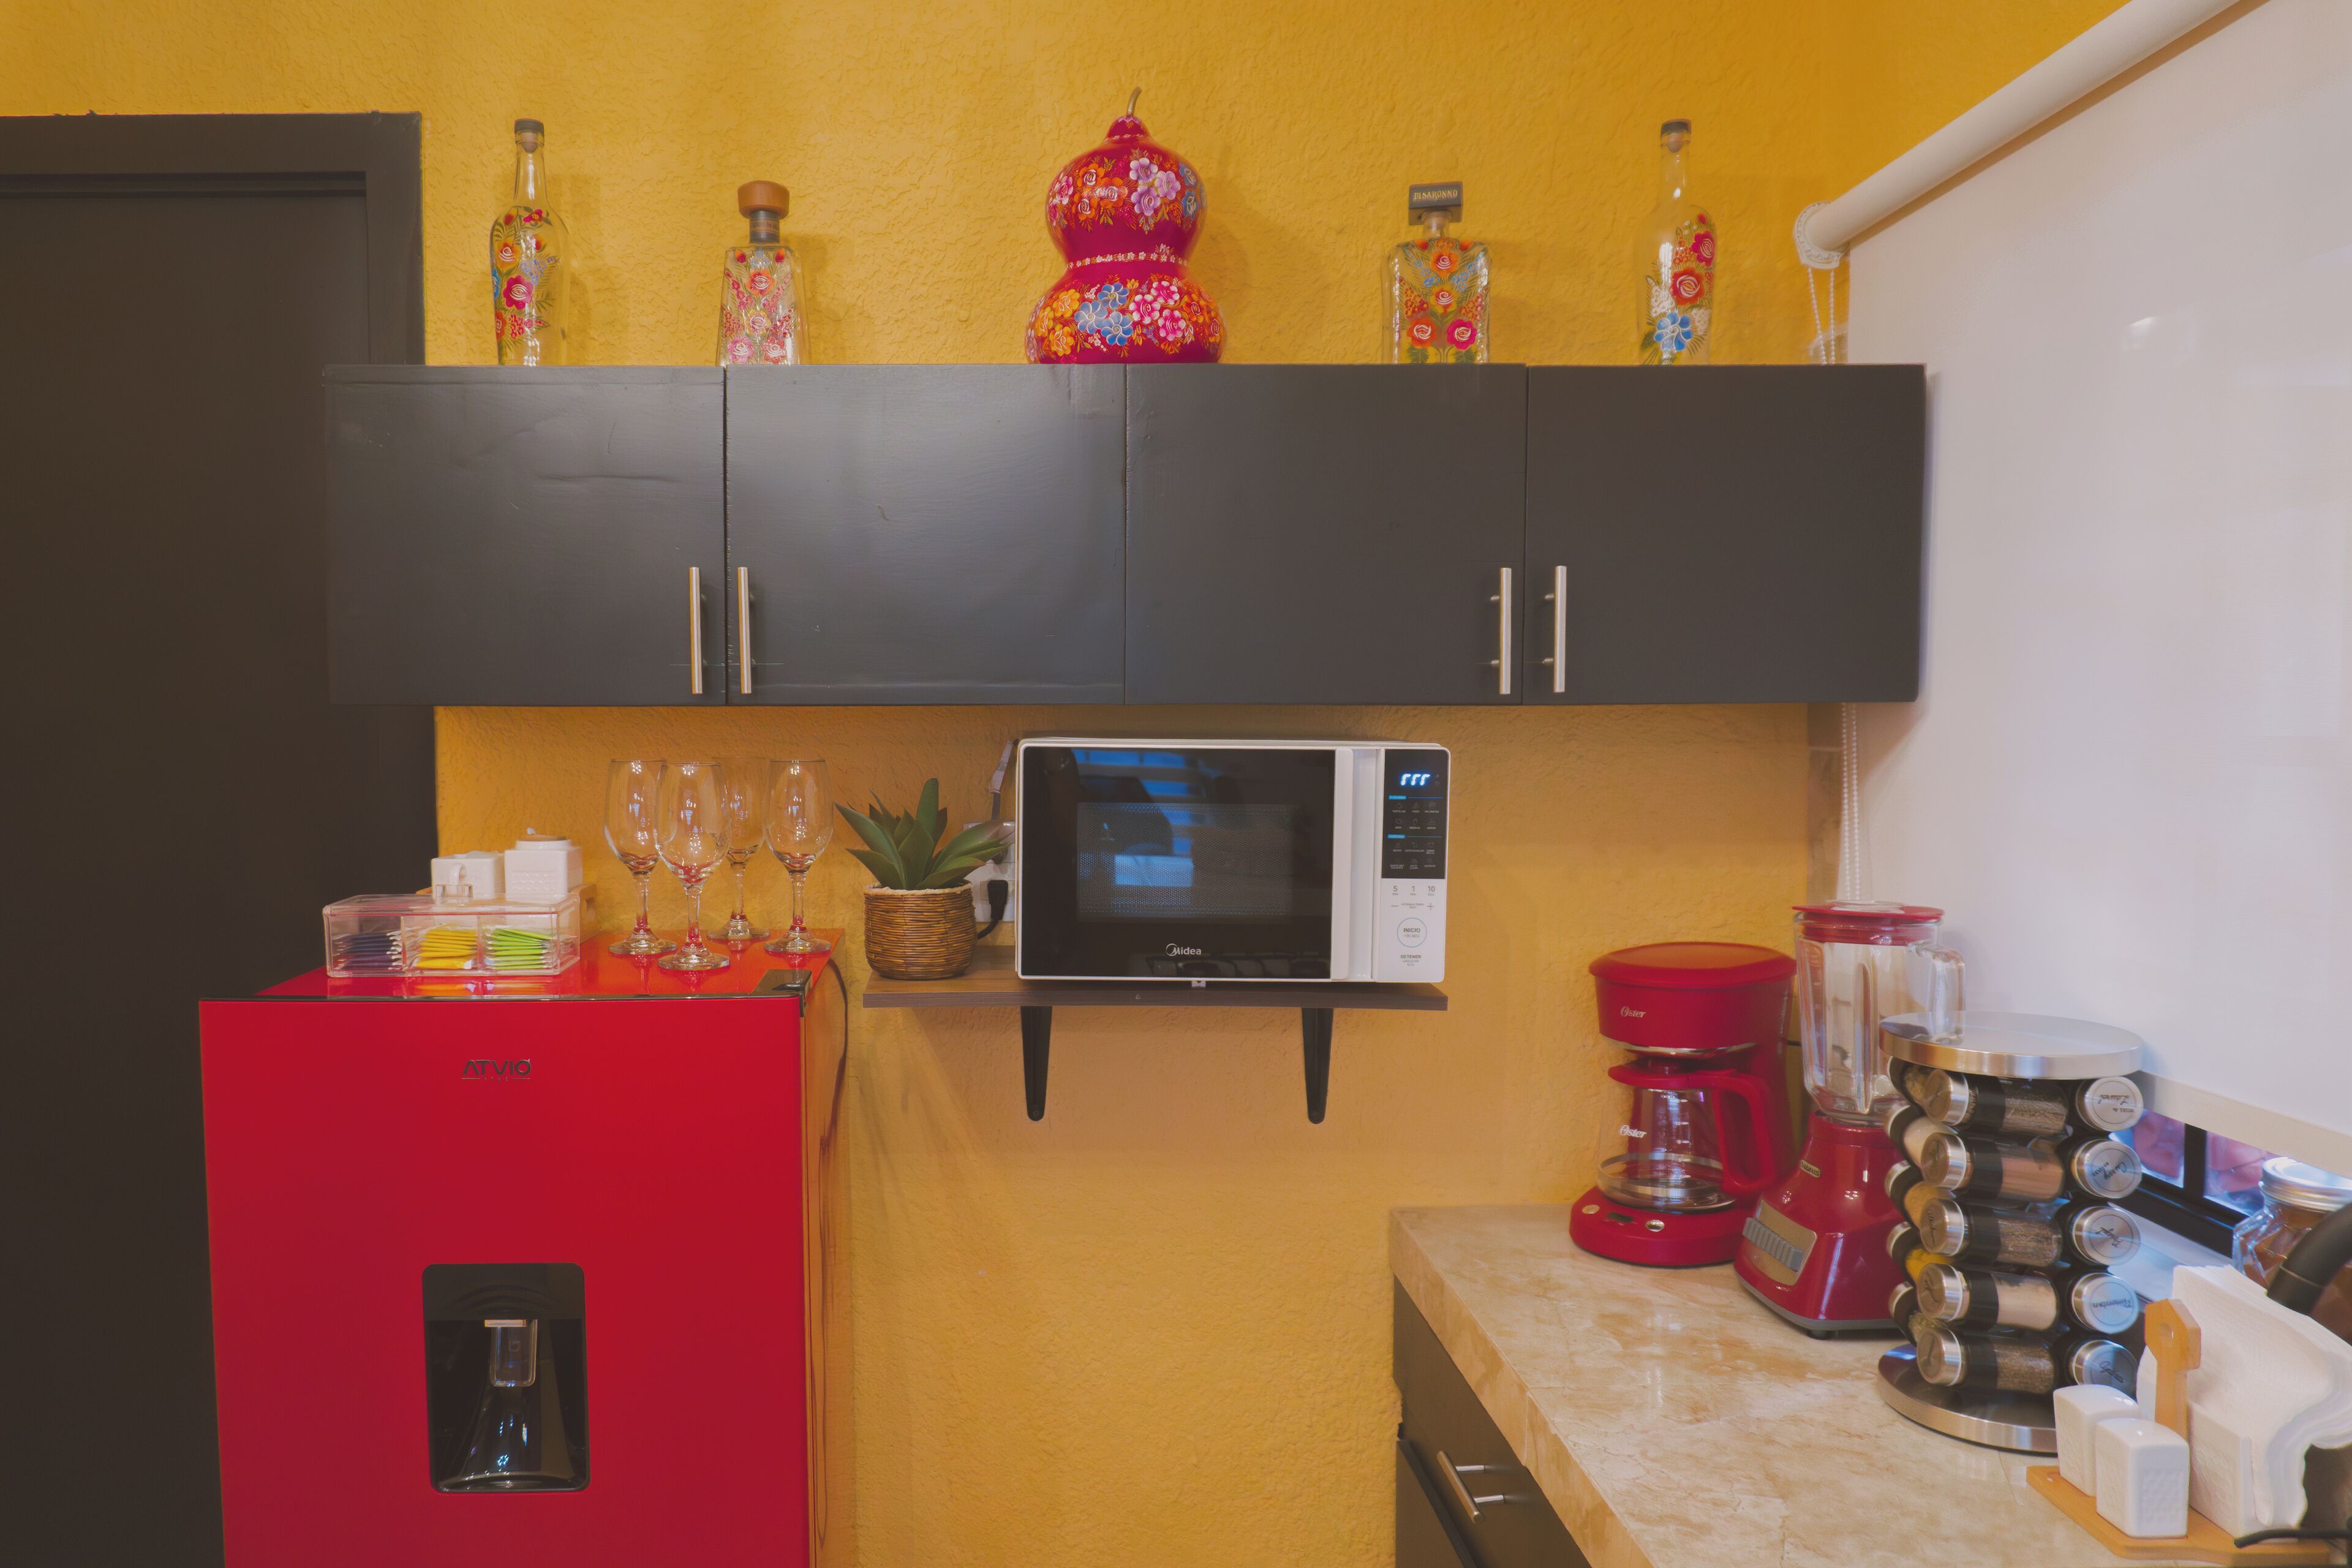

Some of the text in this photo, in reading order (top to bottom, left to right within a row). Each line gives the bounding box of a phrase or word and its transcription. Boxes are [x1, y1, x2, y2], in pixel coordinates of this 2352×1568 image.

[1414, 189, 1458, 200] DISARONNO
[1167, 945, 1202, 956] Midea
[1621, 1006, 1646, 1018] Oster
[462, 1060, 532, 1076] ATVIO
[1620, 1125, 1647, 1138] Oster
